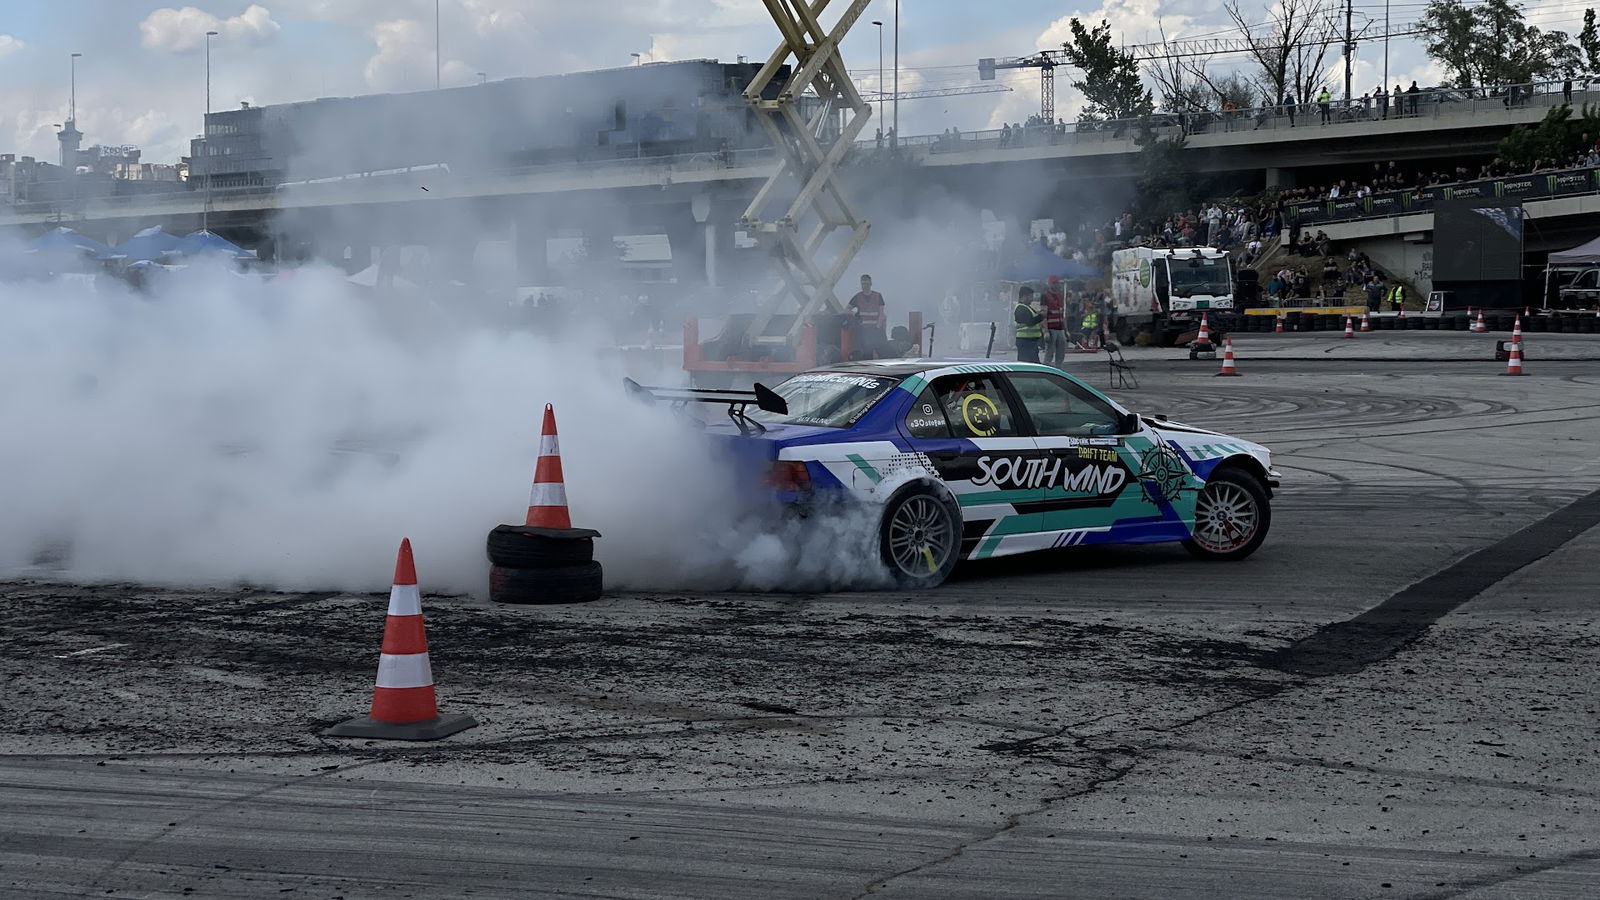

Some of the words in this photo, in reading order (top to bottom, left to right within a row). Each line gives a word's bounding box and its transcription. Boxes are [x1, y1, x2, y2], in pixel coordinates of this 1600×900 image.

[1079, 447, 1098, 460] DRIFT
[1099, 449, 1118, 462] TEAM
[972, 456, 1061, 488] SOUTH
[1064, 464, 1125, 494] WIND
